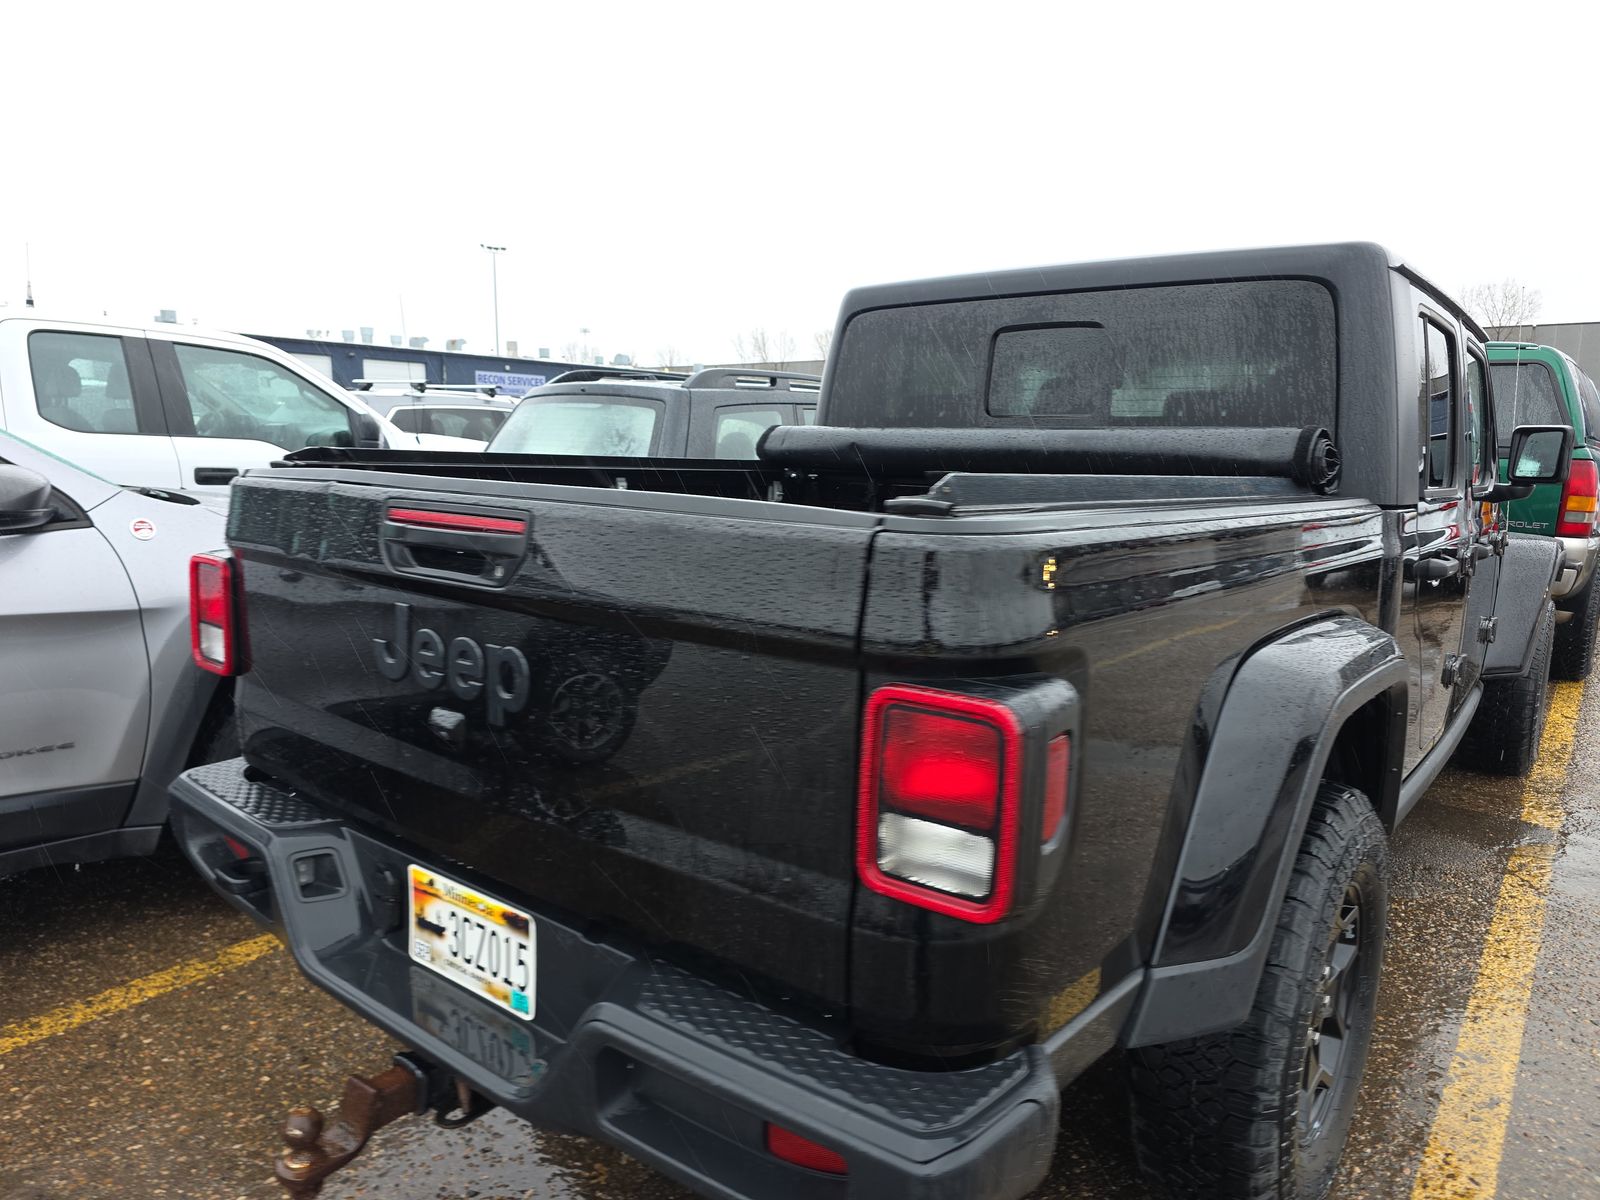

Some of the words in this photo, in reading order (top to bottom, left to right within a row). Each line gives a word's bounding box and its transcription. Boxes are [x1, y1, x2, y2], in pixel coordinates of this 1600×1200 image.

[477, 374, 506, 385] RECON
[507, 376, 545, 387] SERVICES
[372, 602, 530, 727] Jeep
[442, 883, 495, 915] Minnesta
[449, 910, 530, 992] 3CZ015
